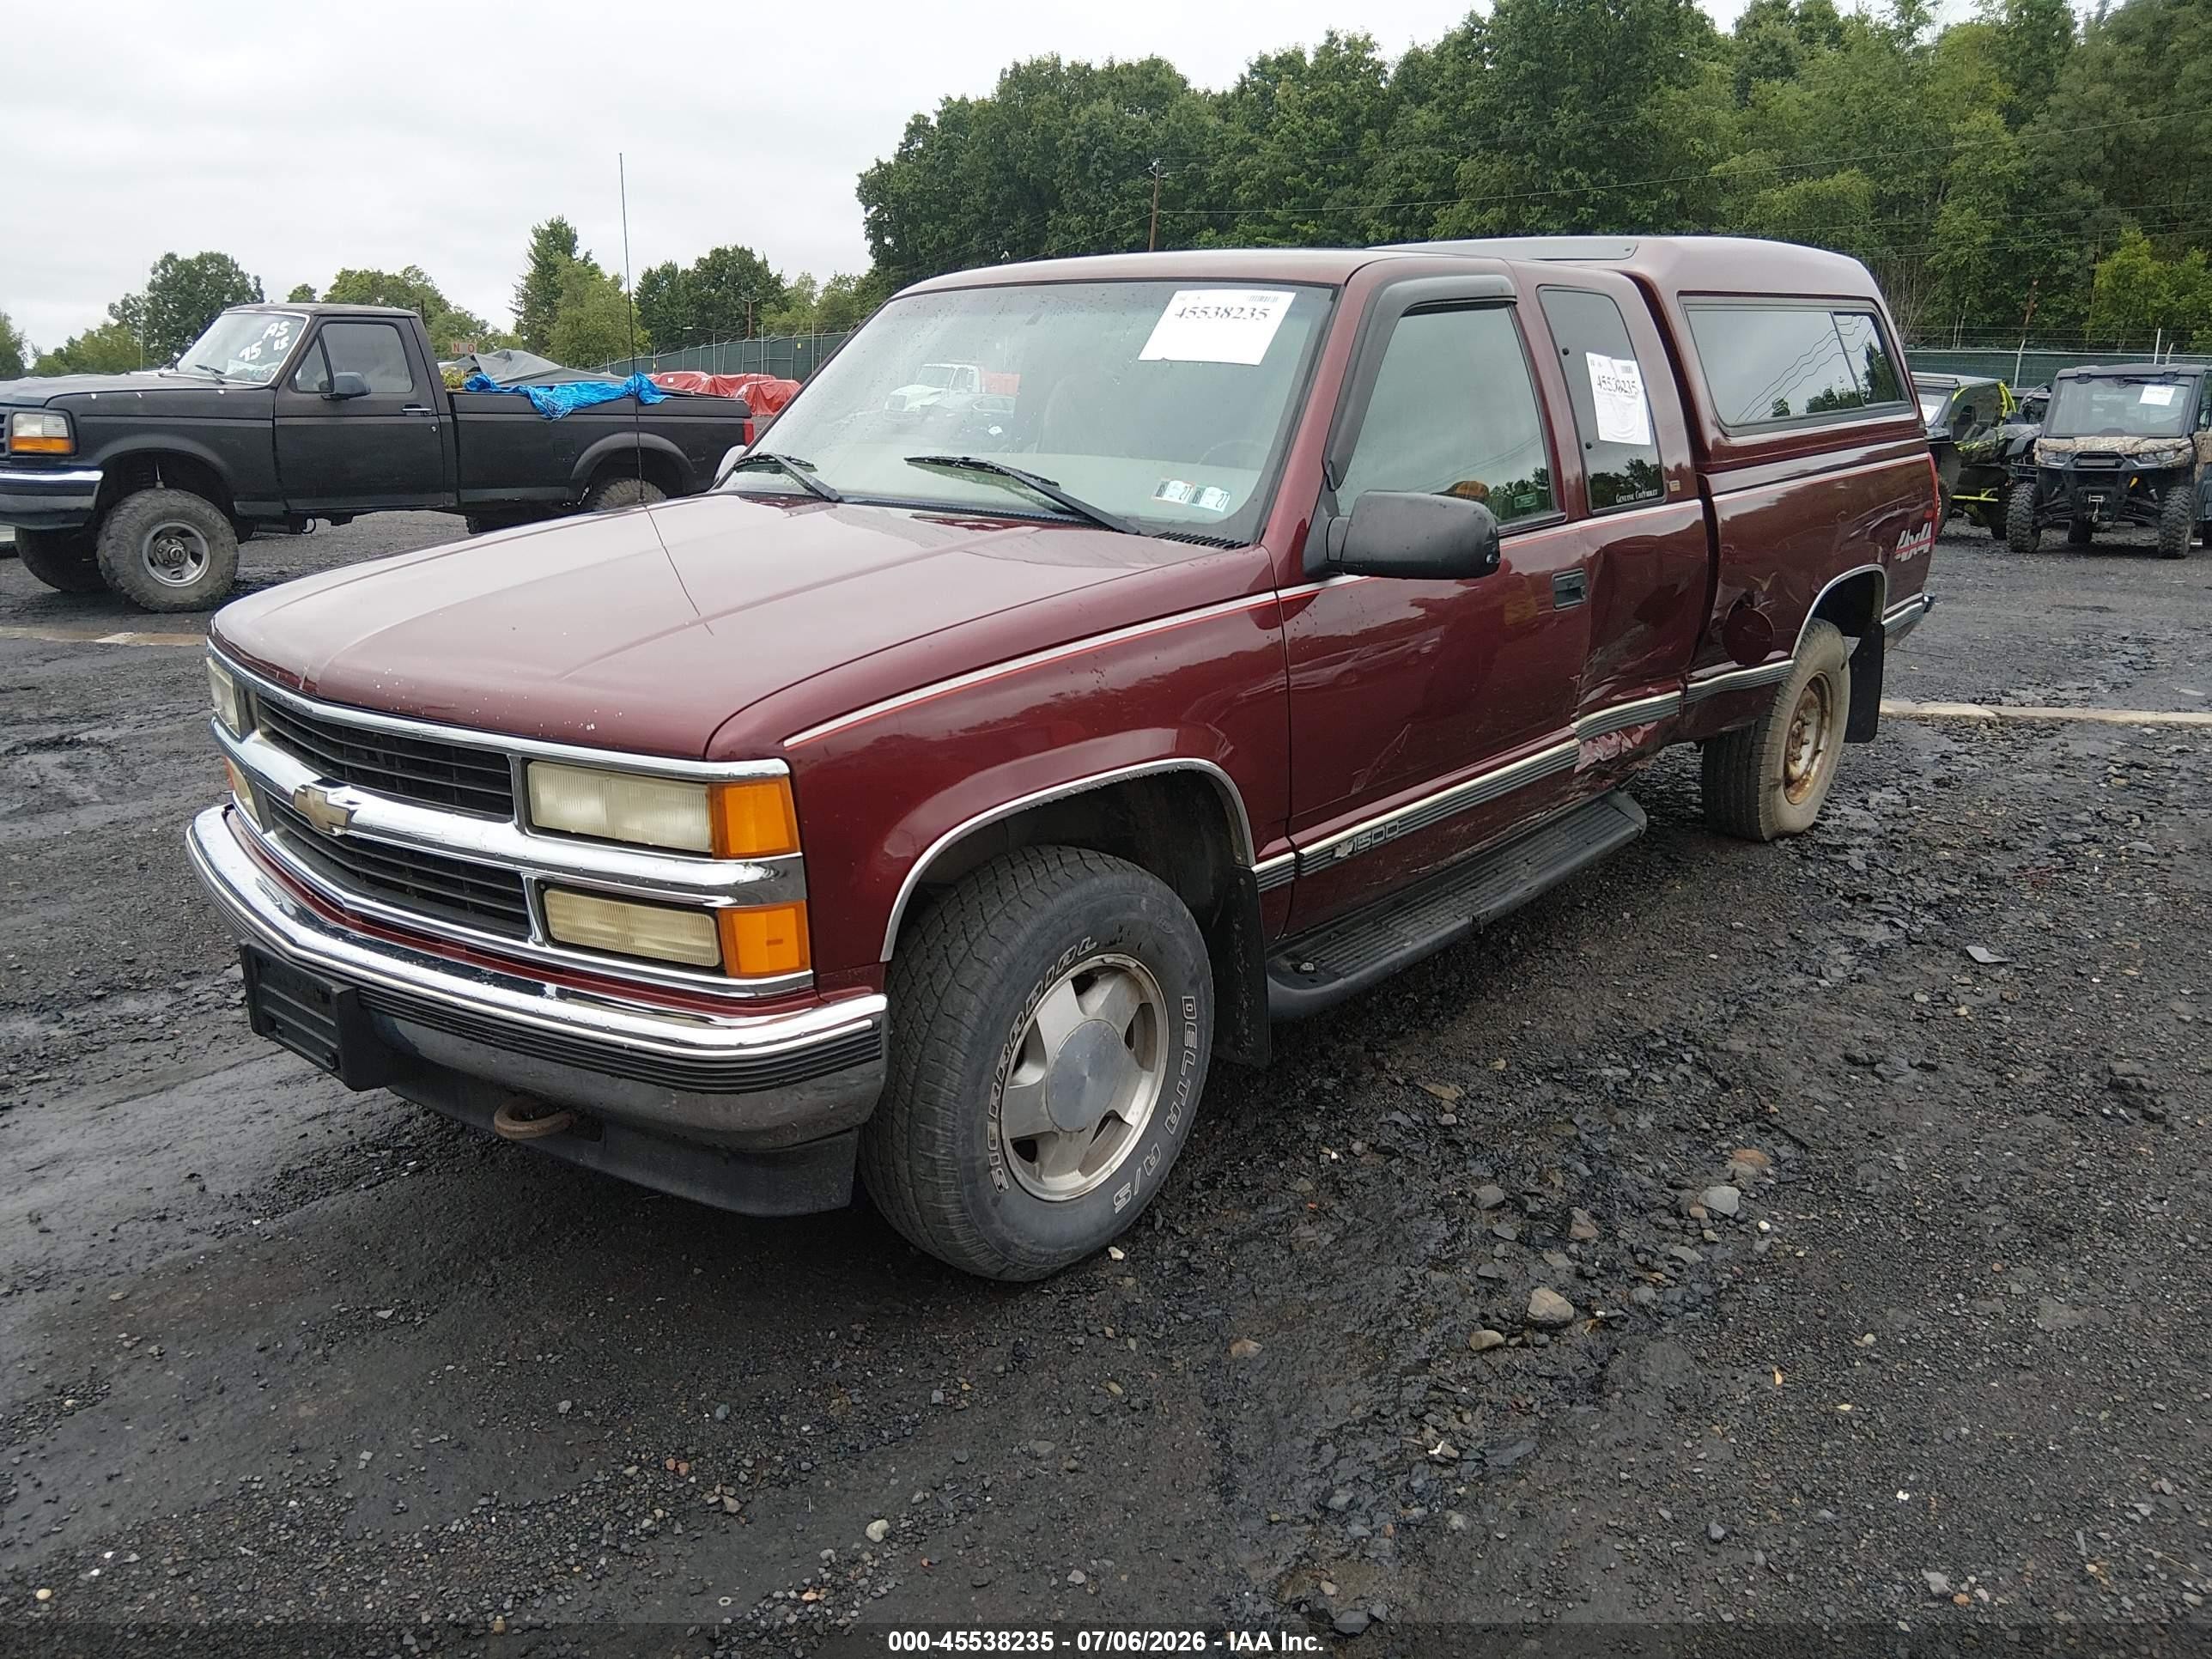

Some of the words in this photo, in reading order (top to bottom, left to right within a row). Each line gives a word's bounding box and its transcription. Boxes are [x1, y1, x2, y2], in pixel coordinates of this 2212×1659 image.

[1175, 306, 1270, 321] 45538235
[262, 320, 290, 339] AS
[1353, 821, 1400, 853] 1500
[1164, 995, 1197, 1135] DELTA
